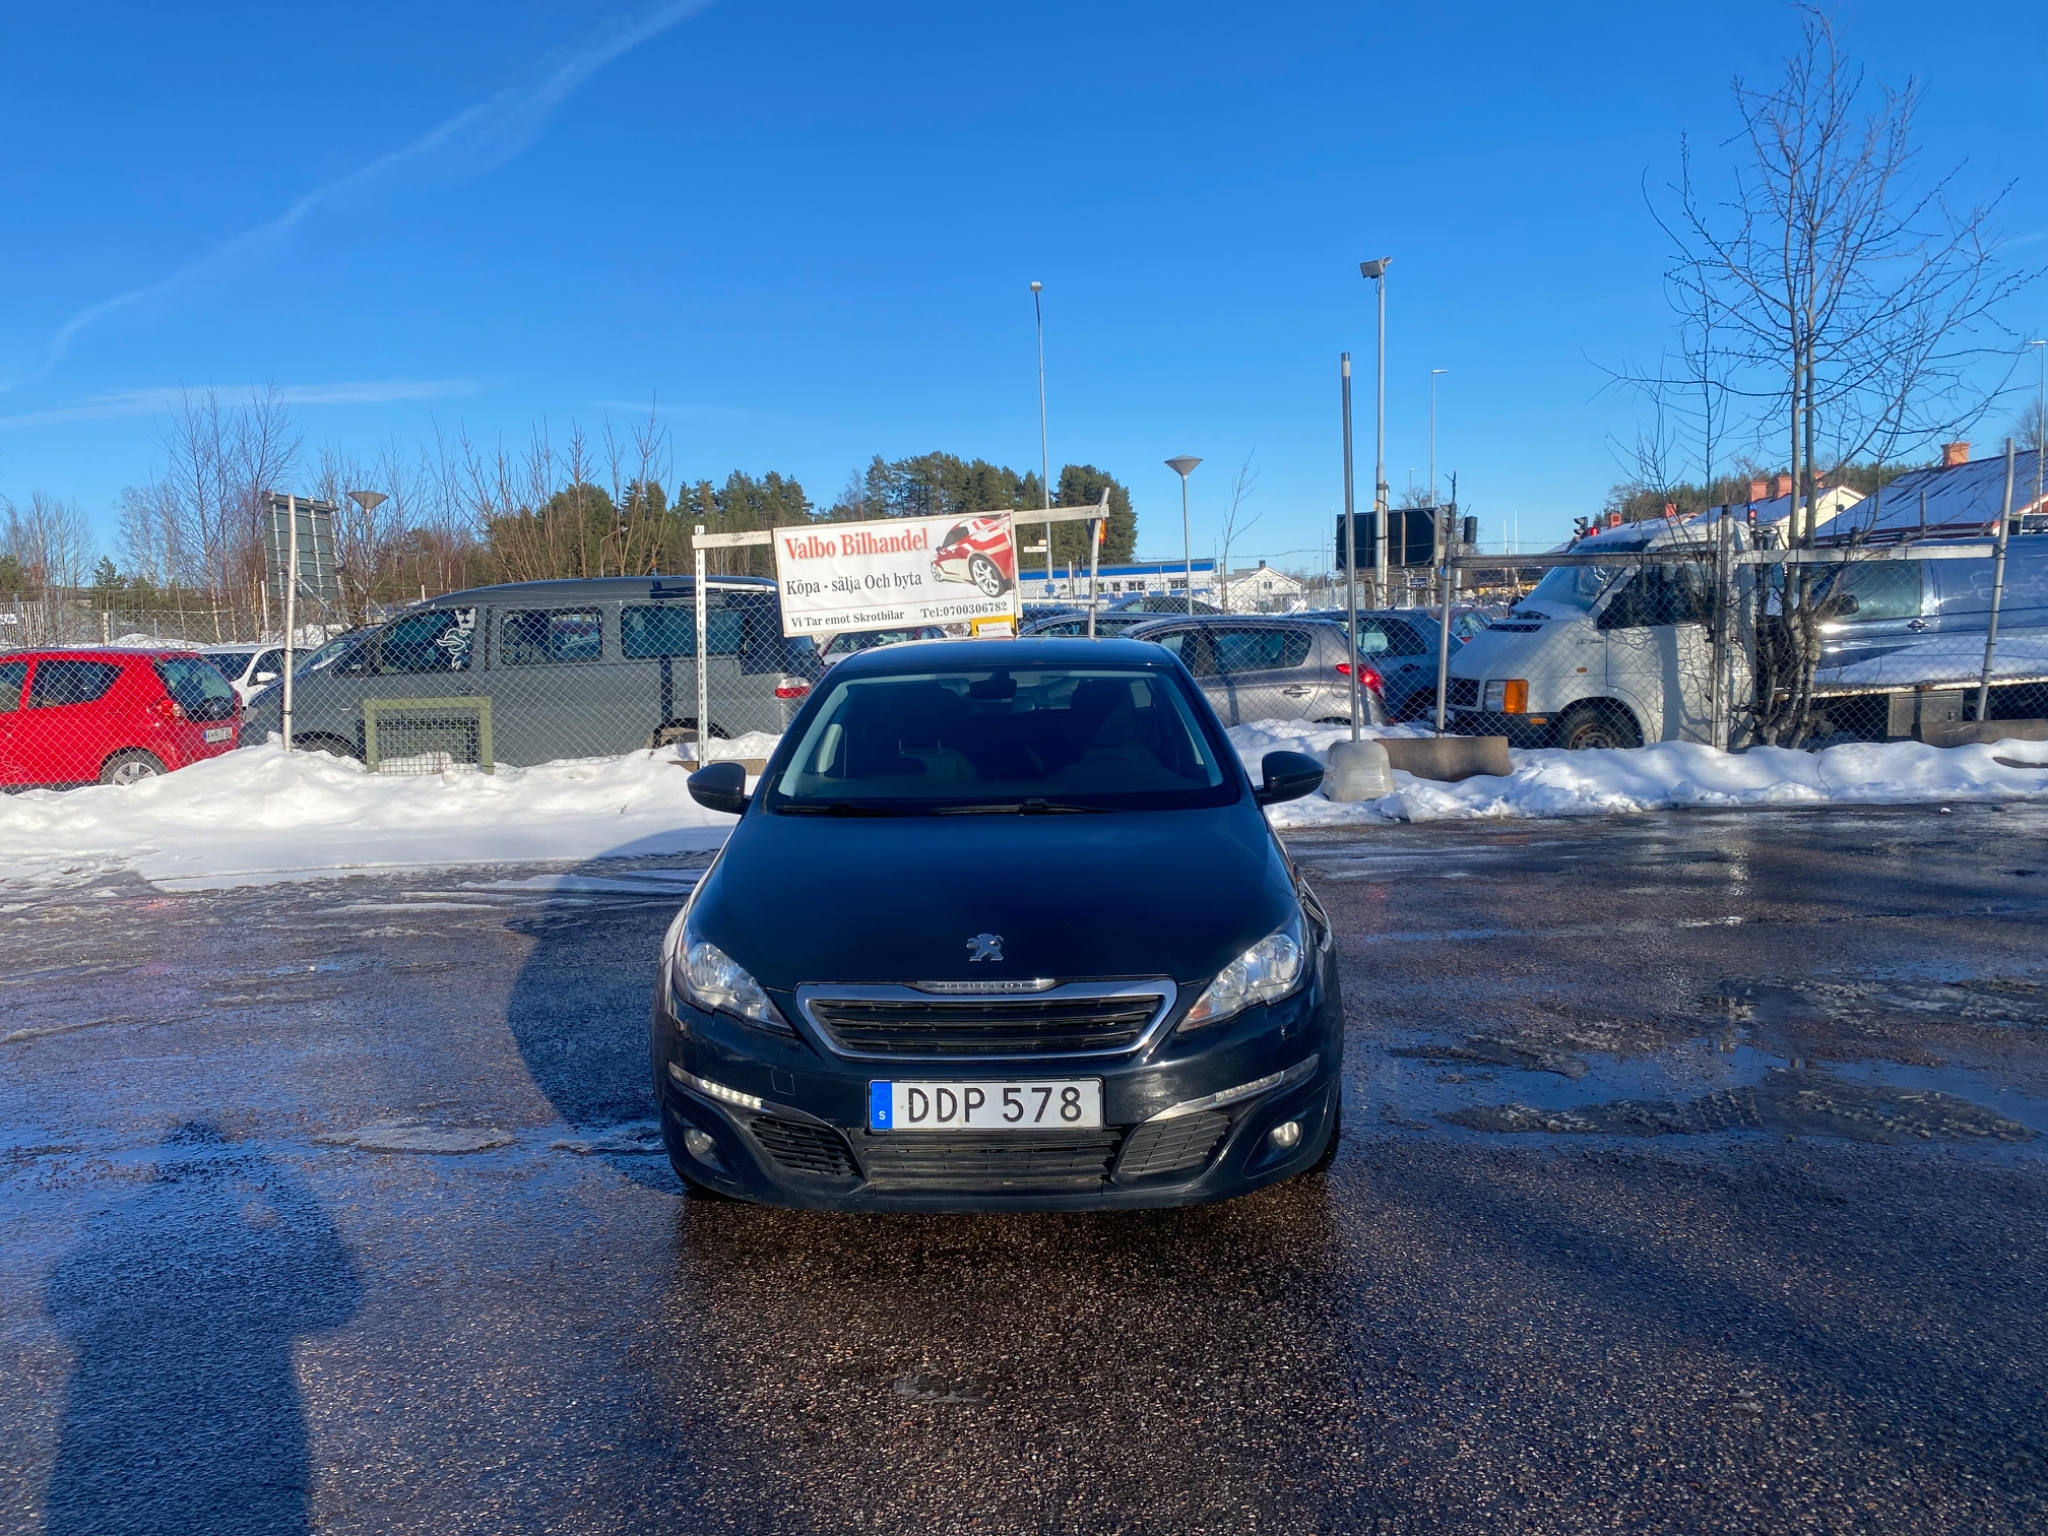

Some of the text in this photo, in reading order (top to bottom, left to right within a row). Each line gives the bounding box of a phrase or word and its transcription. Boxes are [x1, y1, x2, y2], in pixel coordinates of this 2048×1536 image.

[785, 528, 929, 560] Valbo Bilhandel
[786, 579, 820, 597] Köpa
[832, 575, 861, 594] sälja
[865, 573, 891, 589] Och
[894, 571, 922, 590] byta
[791, 610, 904, 627] Vi Tar emot Skrotbilar
[920, 601, 1008, 618] Tel:0700306782
[907, 1086, 1082, 1123] DDP 578
[878, 1110, 886, 1121] S
